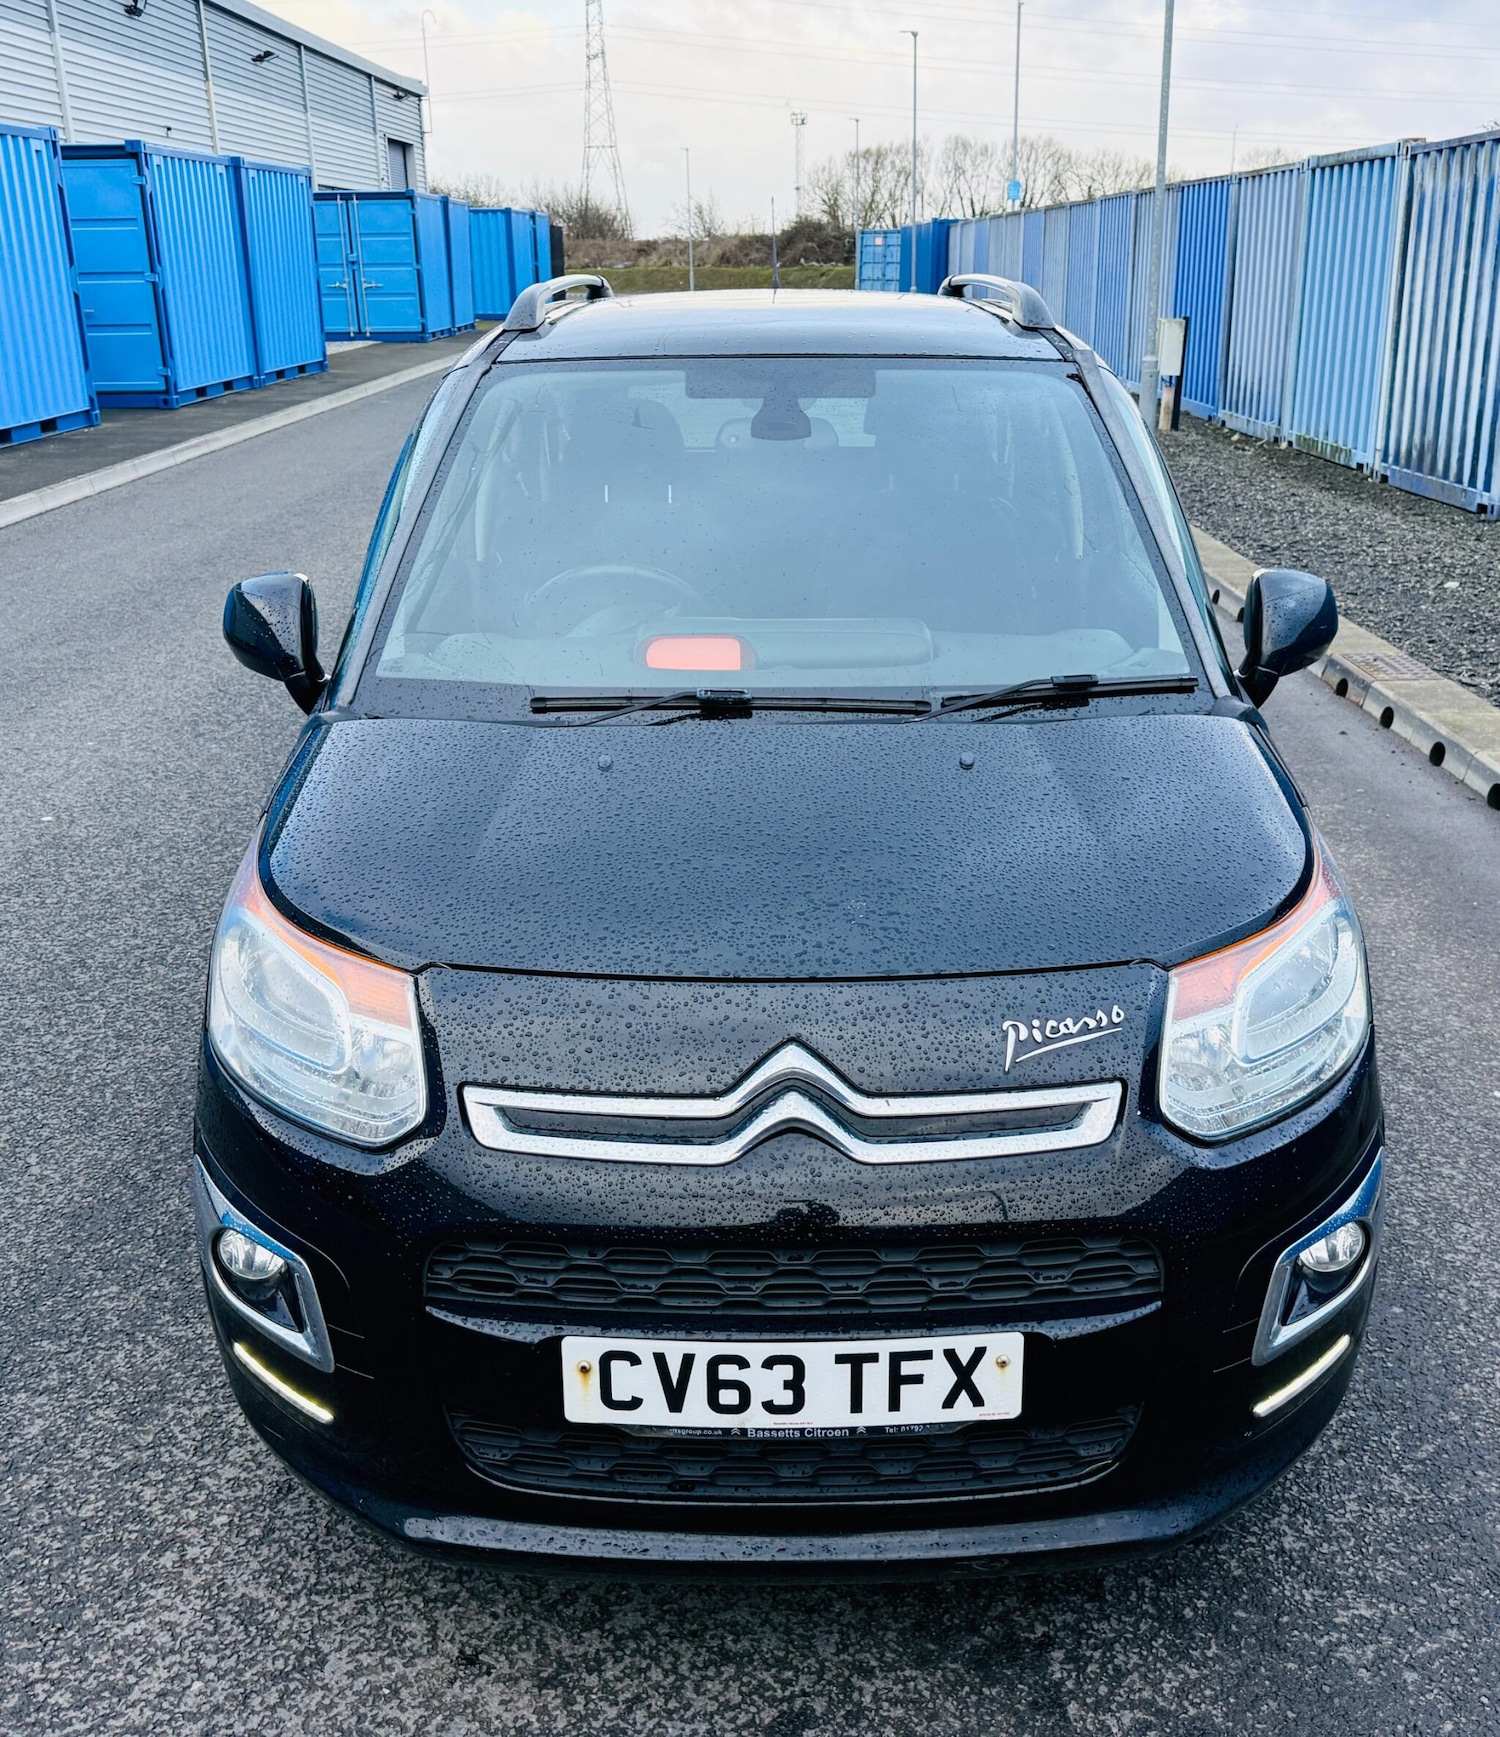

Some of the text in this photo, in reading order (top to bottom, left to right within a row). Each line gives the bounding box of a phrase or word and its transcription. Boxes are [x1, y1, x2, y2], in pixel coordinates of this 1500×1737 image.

[1002, 1005, 1124, 1071] Picasso
[599, 1346, 987, 1415] CV63 TFX
[747, 1428, 801, 1438] Bassetts
[804, 1427, 849, 1437] Citroen
